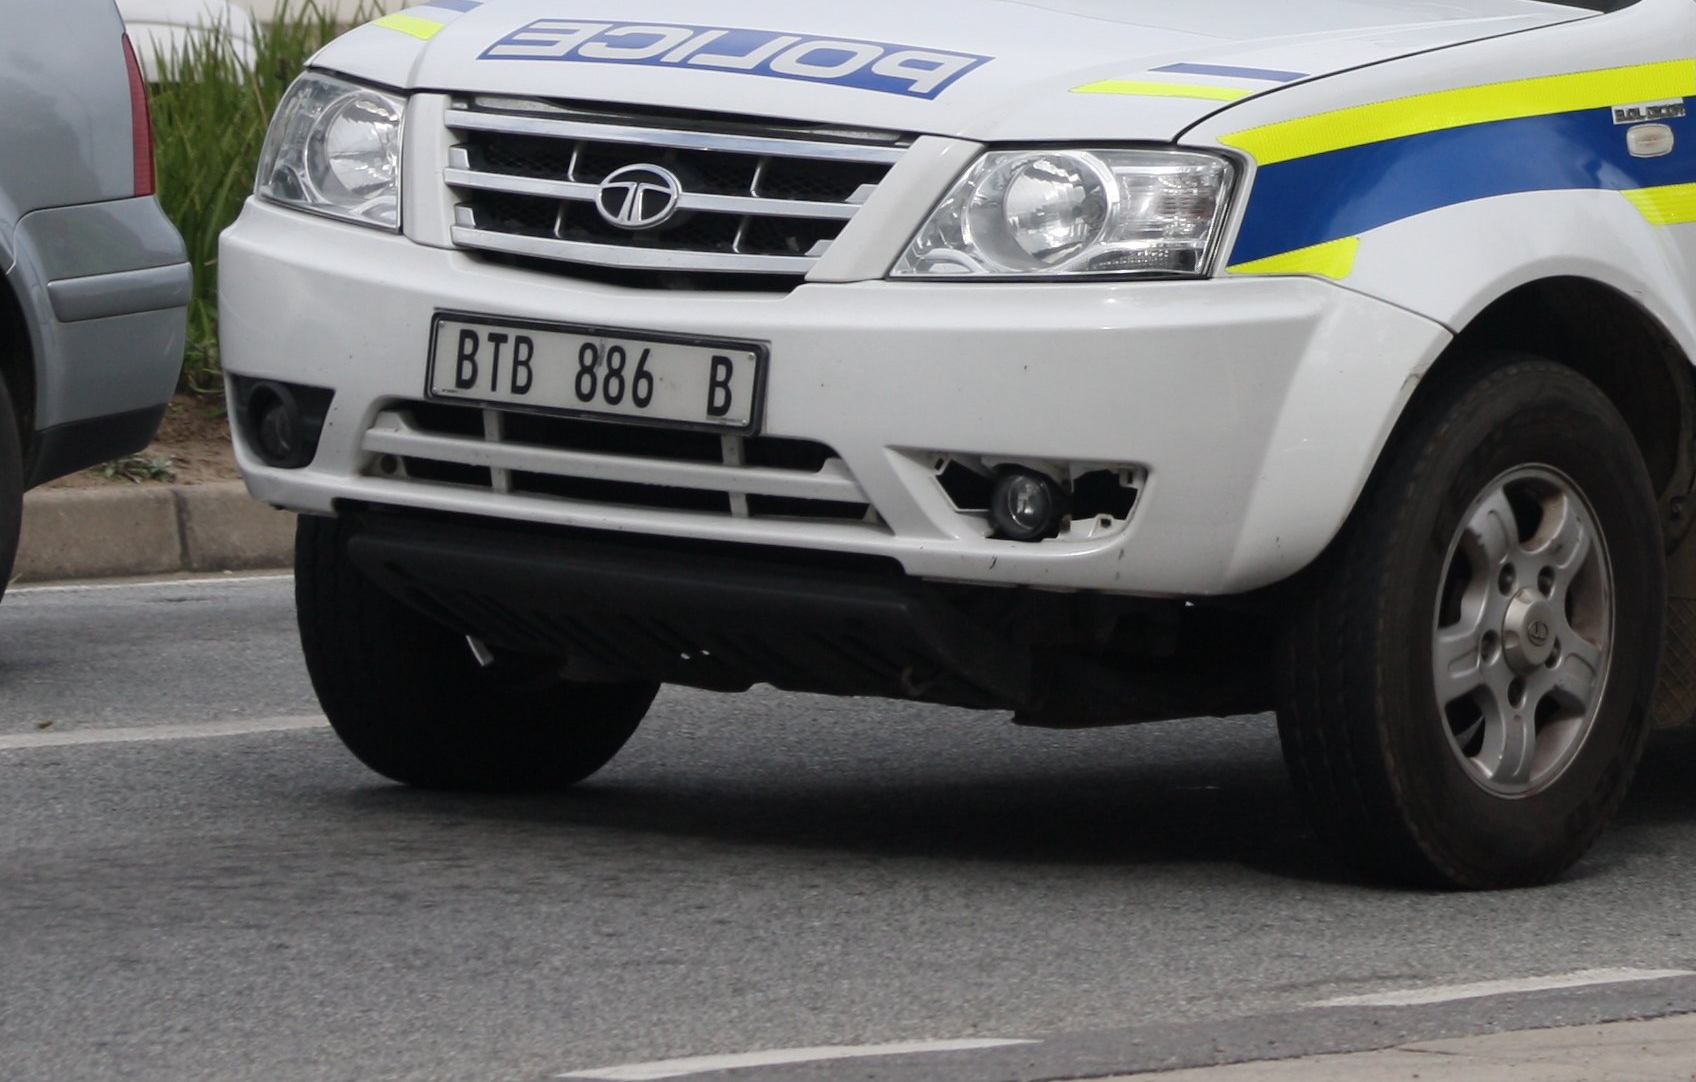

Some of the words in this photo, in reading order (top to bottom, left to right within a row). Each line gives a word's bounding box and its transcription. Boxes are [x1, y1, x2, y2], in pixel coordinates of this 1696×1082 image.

[455, 329, 534, 395] BTB
[574, 342, 656, 408] 886
[706, 354, 734, 417] B
